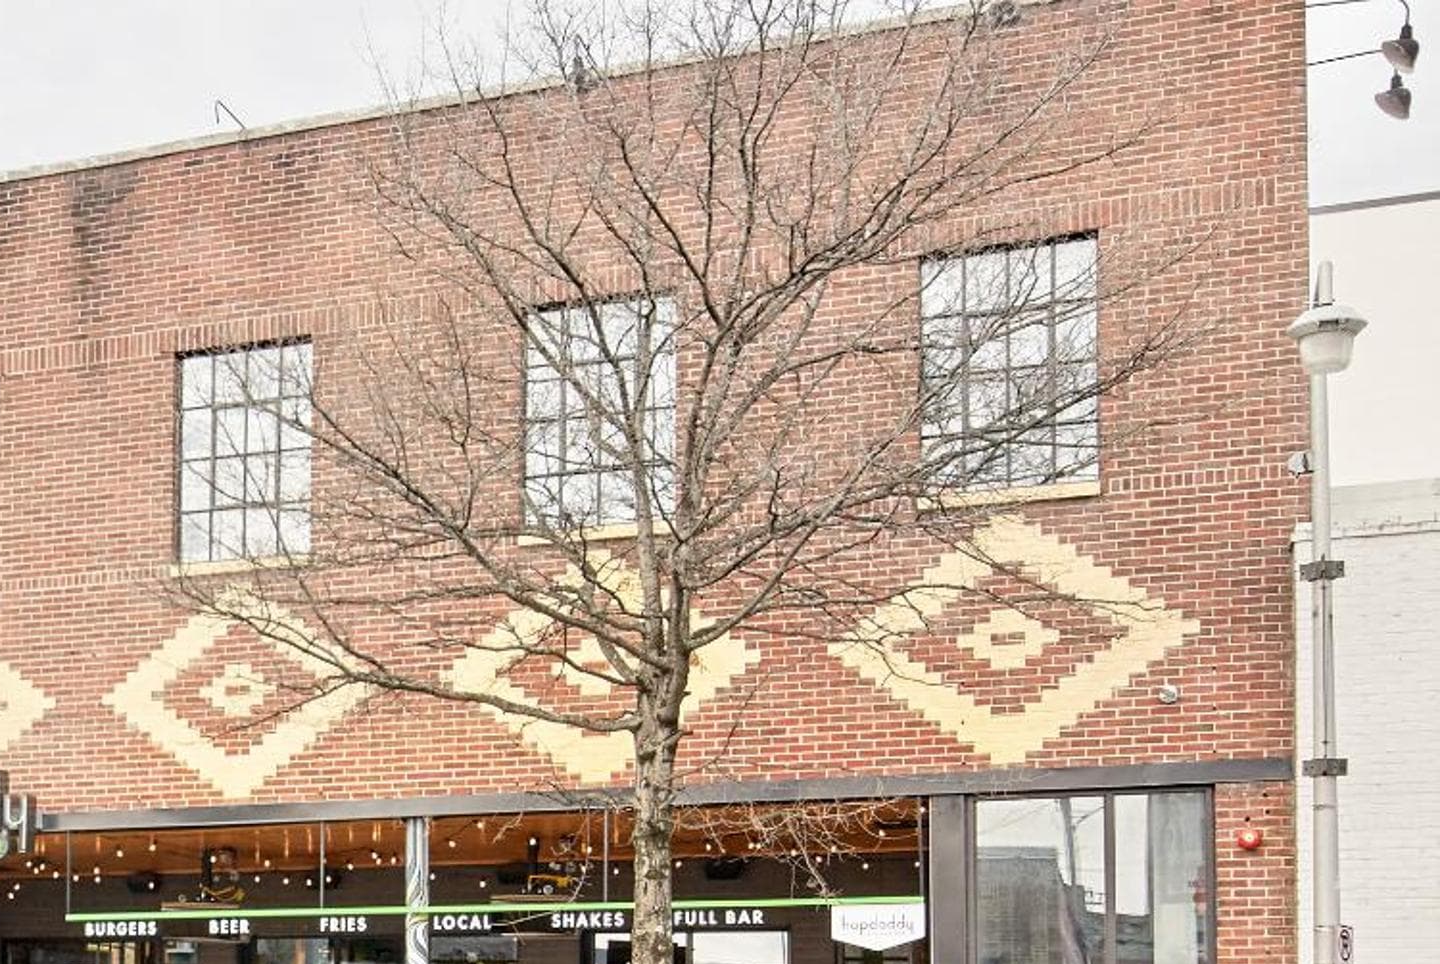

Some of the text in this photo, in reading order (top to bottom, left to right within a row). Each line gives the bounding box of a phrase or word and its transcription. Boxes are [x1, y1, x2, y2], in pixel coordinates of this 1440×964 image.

[84, 909, 765, 937] BURGERS BEER FRIES LOCAL SHAKES FULL BAR
[842, 912, 914, 937] hopdoddy
